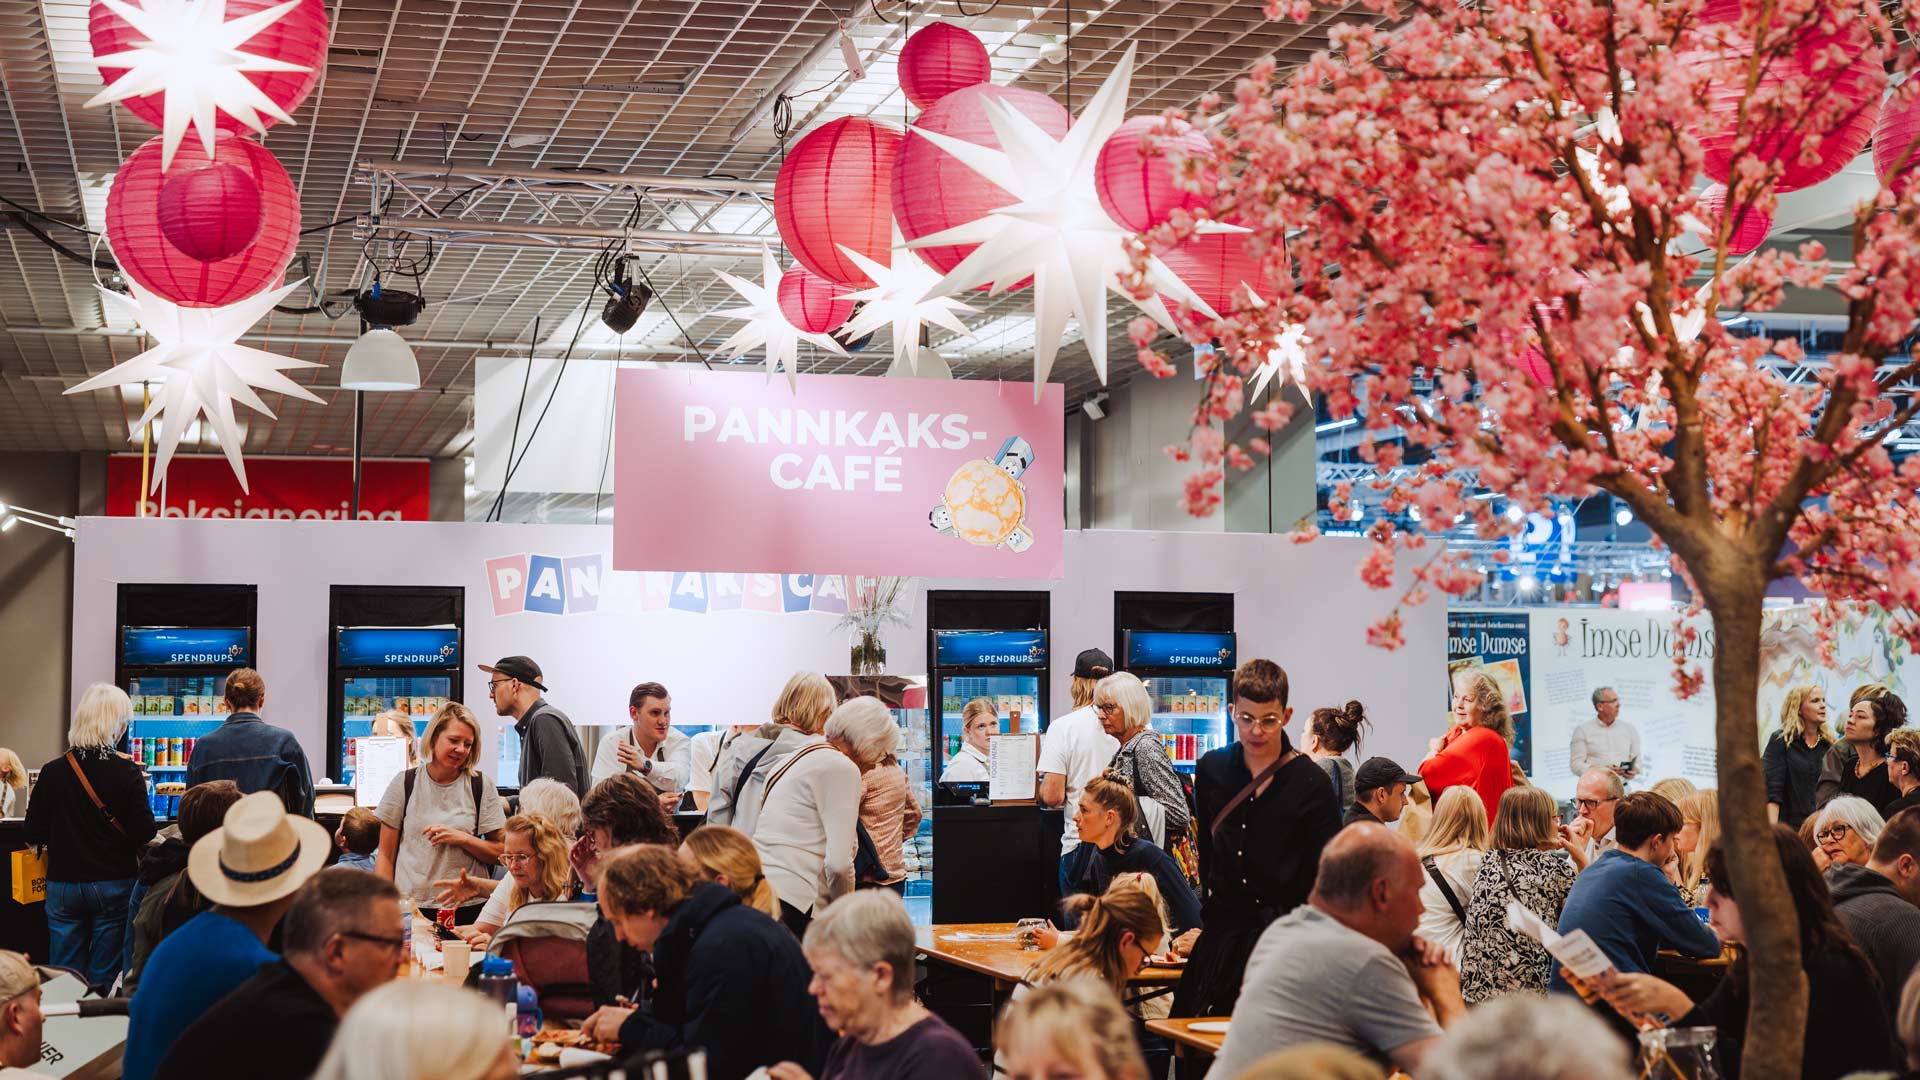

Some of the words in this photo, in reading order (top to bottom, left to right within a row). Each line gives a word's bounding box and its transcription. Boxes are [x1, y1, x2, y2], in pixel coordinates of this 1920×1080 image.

[684, 405, 987, 450] PANNKAKS-
[769, 447, 903, 492] CAFÉ
[1447, 635, 1477, 655] mse
[1480, 631, 1527, 655] Dumse
[1580, 618, 1641, 658] Imse
[1647, 618, 1715, 659] Dums
[171, 653, 233, 662] SPENDRUPS
[384, 654, 445, 663] SPENDRUPS
[979, 654, 1033, 663] SPENDRUPS
[1169, 656, 1223, 665] SPENDRUPS
